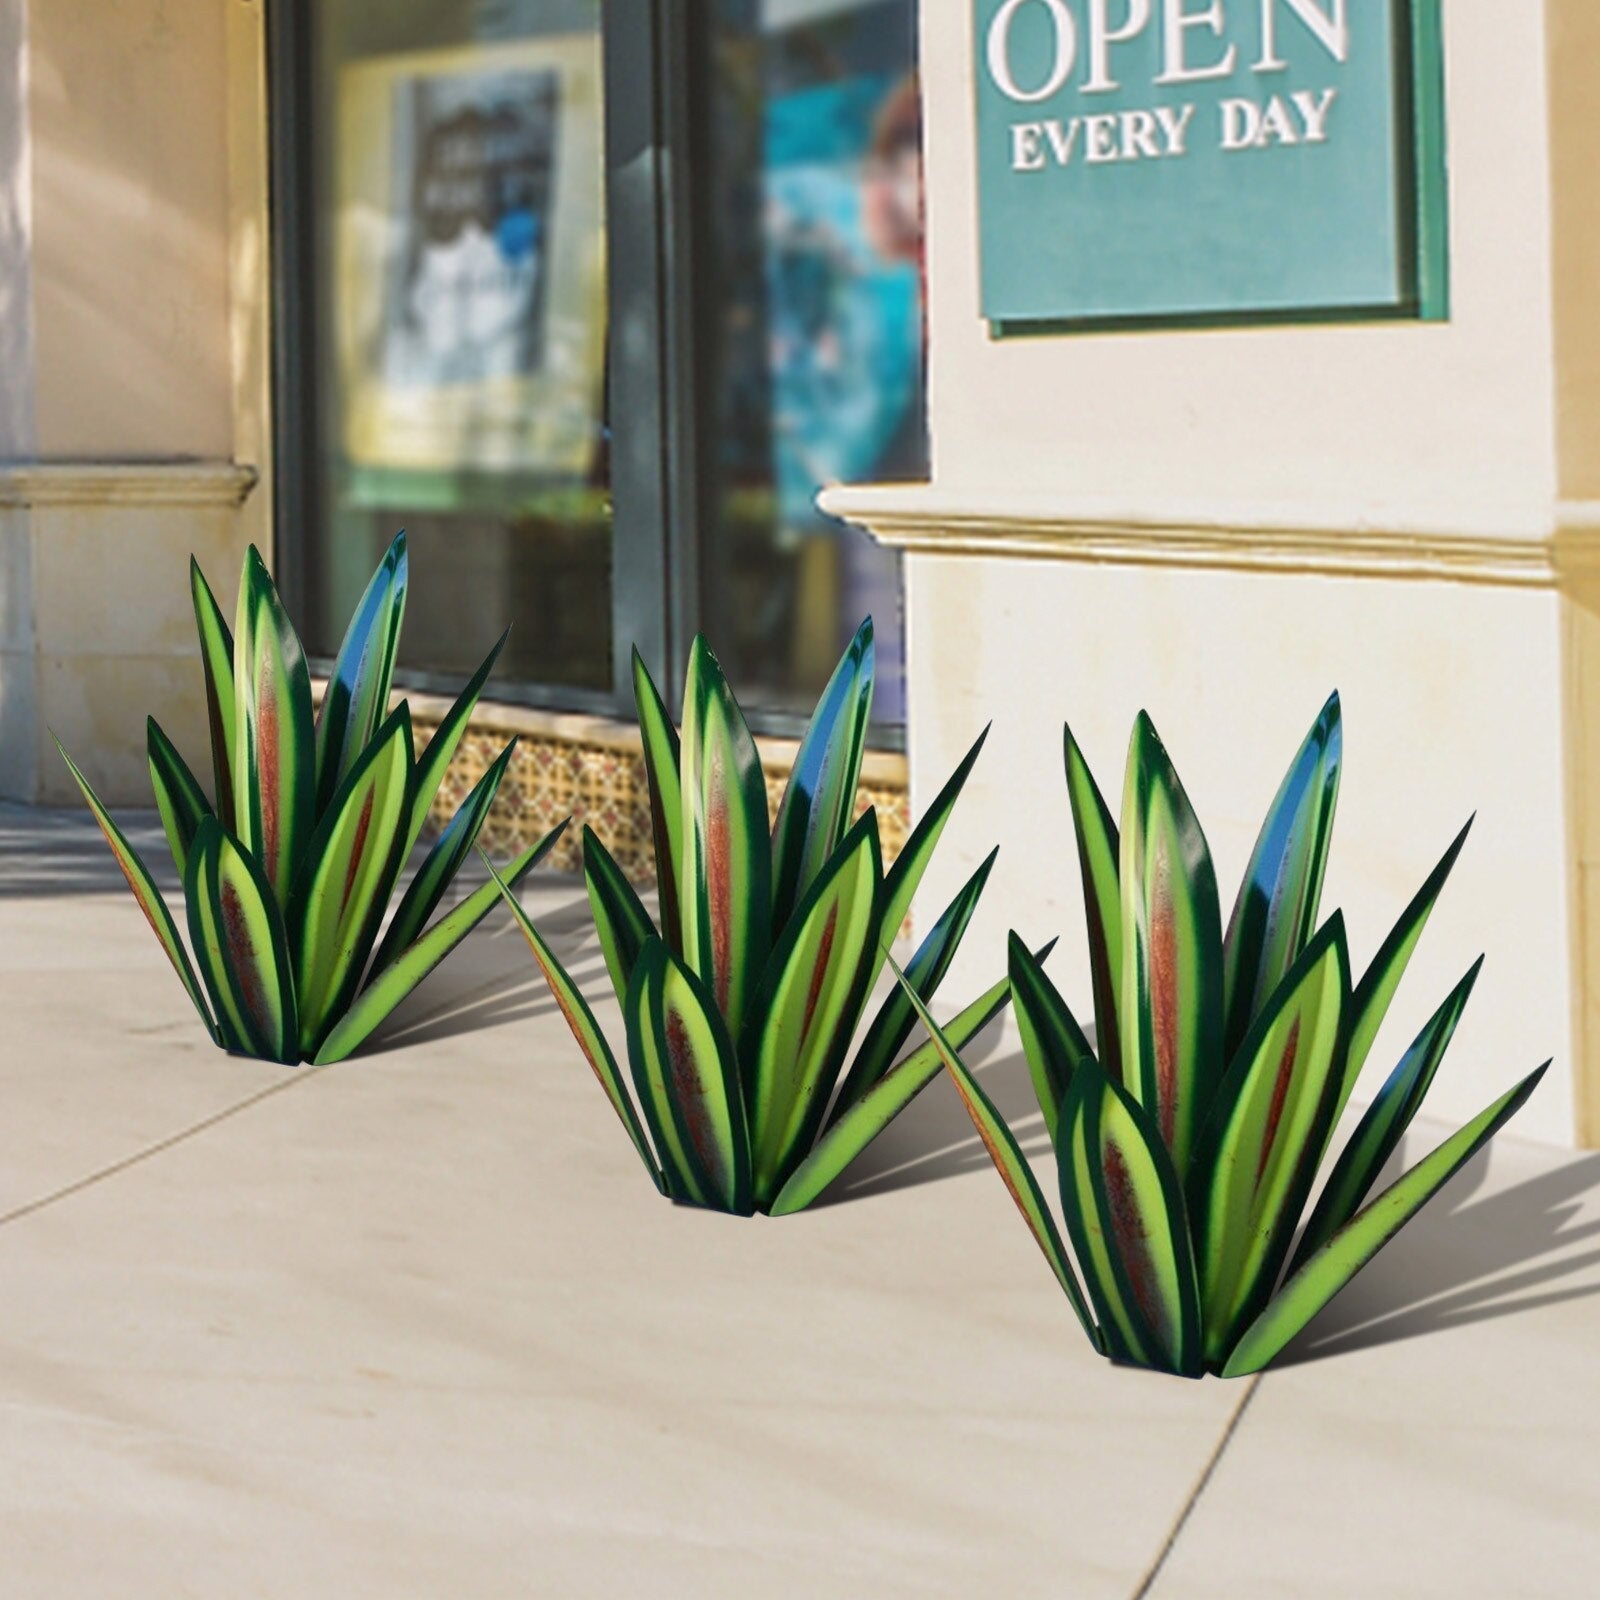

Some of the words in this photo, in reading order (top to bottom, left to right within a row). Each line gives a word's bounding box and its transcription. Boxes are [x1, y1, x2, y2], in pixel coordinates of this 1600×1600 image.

[986, 0, 1349, 102] OPEN
[1010, 104, 1195, 171] EVERY
[1219, 88, 1337, 150] DAY
